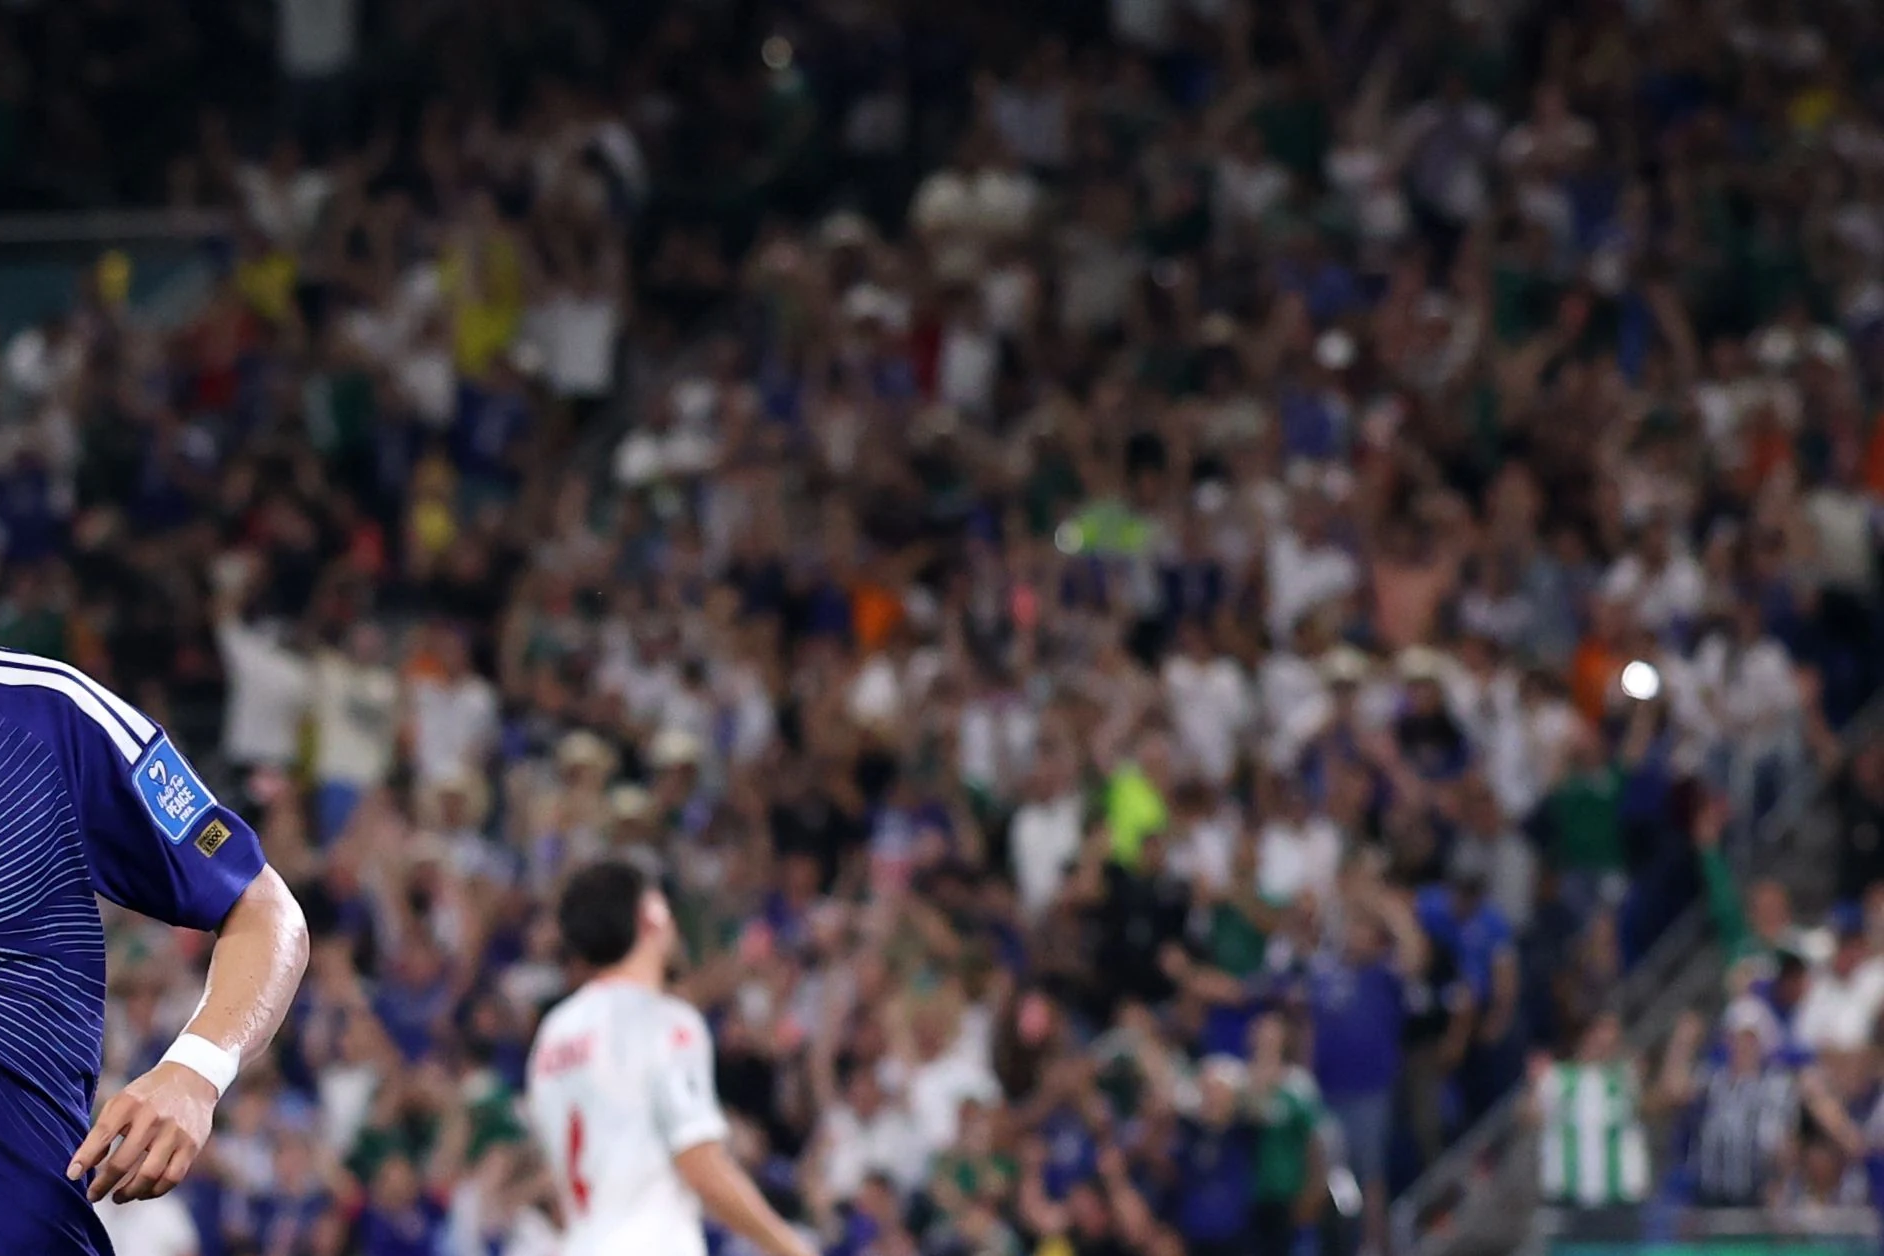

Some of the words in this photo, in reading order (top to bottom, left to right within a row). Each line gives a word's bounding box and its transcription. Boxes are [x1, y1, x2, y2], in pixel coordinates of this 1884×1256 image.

[170, 774, 185, 792] For
[165, 785, 196, 819] PEACE
[179, 805, 196, 823] FIFA
